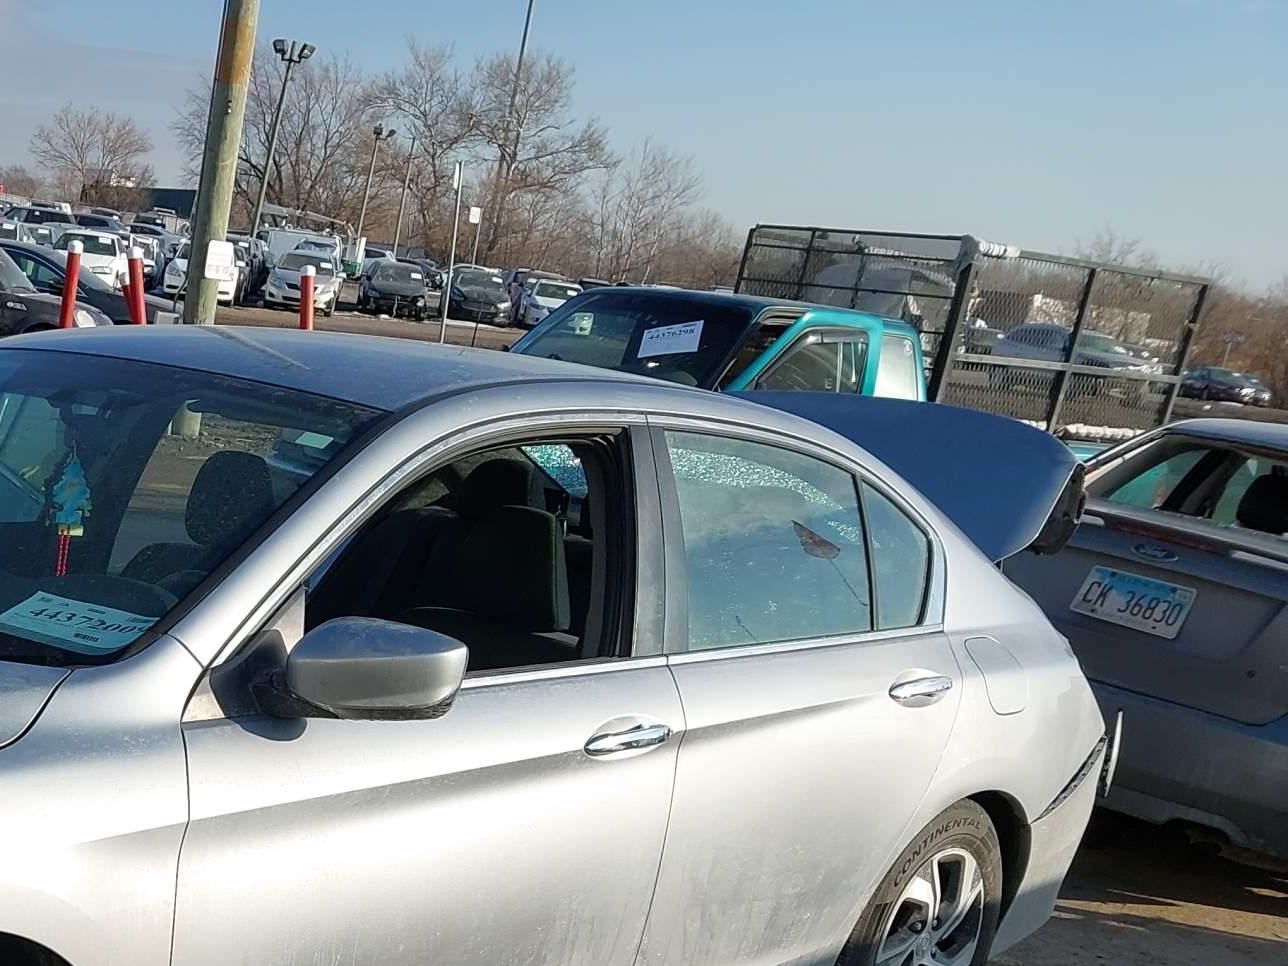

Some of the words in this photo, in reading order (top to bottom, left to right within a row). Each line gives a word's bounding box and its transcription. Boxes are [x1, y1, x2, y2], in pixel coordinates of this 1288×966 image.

[1082, 581, 1113, 607] CK
[1117, 590, 1183, 626] 36830
[894, 818, 981, 887] CONTINENTAL
